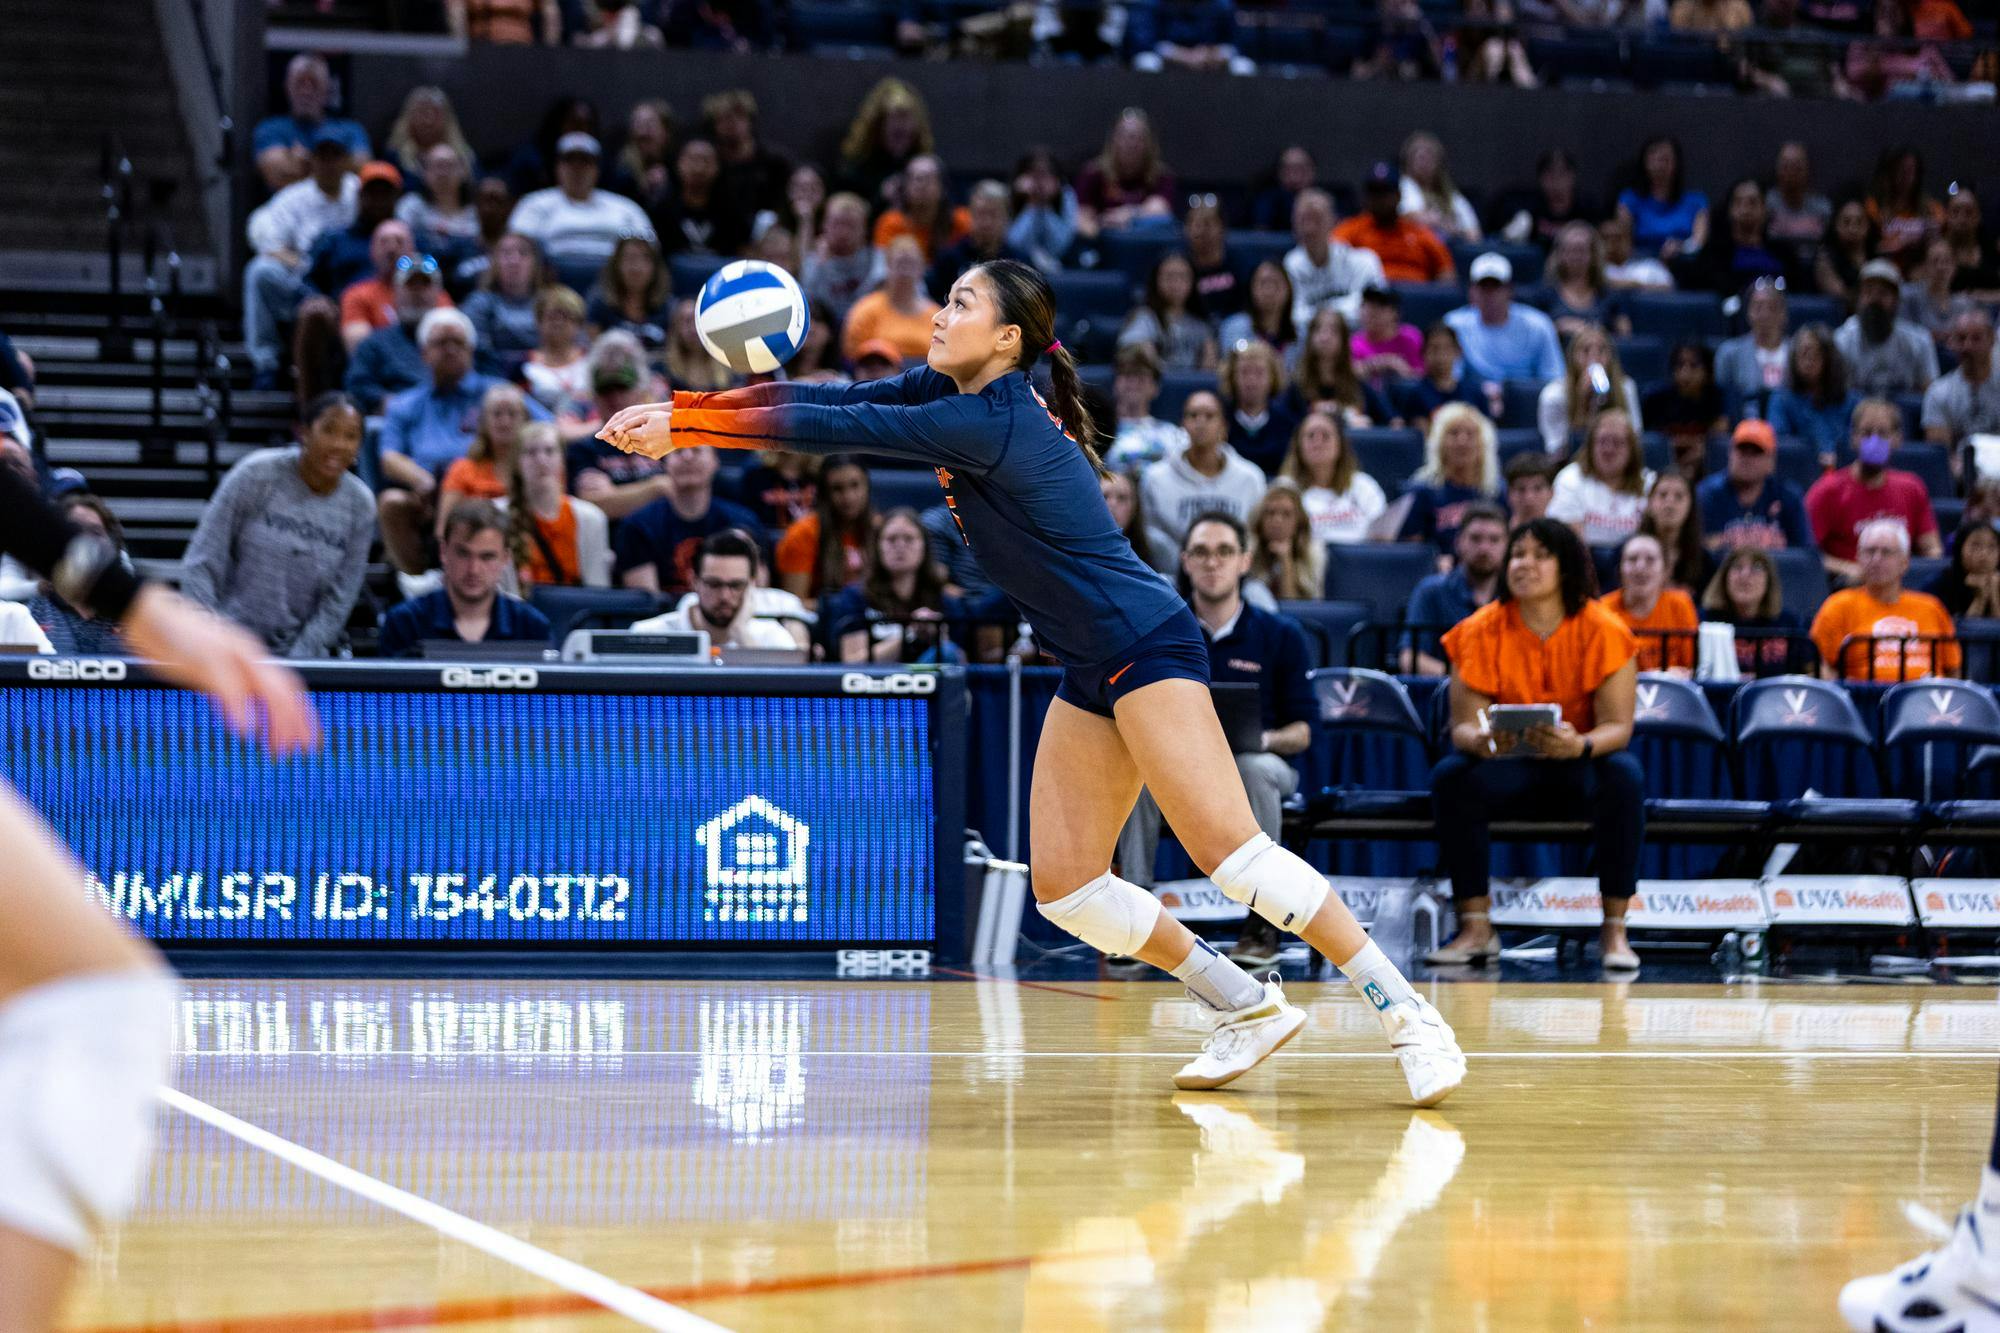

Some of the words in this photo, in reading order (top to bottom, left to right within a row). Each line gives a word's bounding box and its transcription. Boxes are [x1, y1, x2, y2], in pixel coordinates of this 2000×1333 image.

[27, 659, 127, 680] GEICO
[440, 667, 539, 688] GEICO
[841, 672, 937, 694] GEICO
[311, 871, 388, 920] ID:
[409, 872, 630, 921] 1540312
